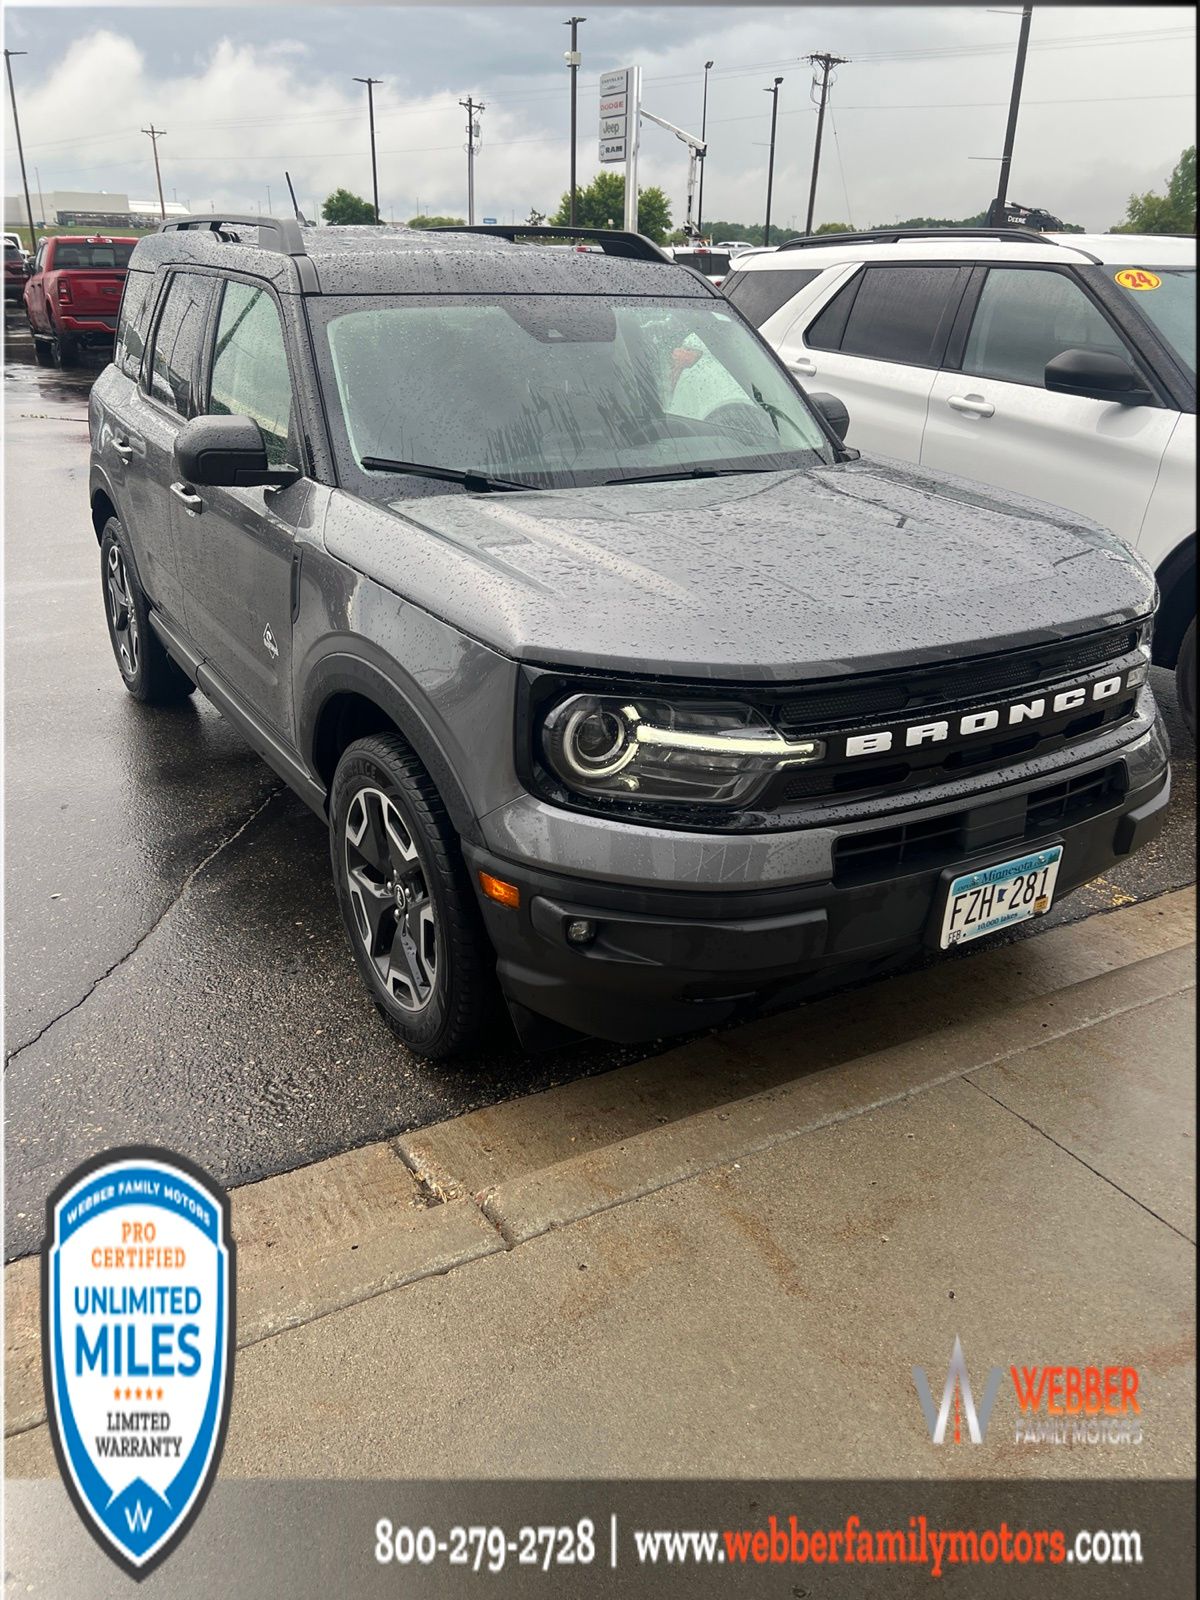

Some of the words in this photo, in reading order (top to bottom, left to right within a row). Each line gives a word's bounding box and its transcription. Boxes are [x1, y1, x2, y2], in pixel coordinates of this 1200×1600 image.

[600, 101, 624, 111] DODGE
[603, 122, 620, 135] Jeep
[605, 145, 623, 154] RAM
[1124, 272, 1153, 289] 24
[845, 676, 1122, 757] BRONCO
[980, 861, 1034, 883] Minnesota
[949, 884, 996, 930] FZH
[1008, 866, 1049, 910] 281
[1000, 911, 1019, 924] lakes
[948, 929, 962, 944] FEB
